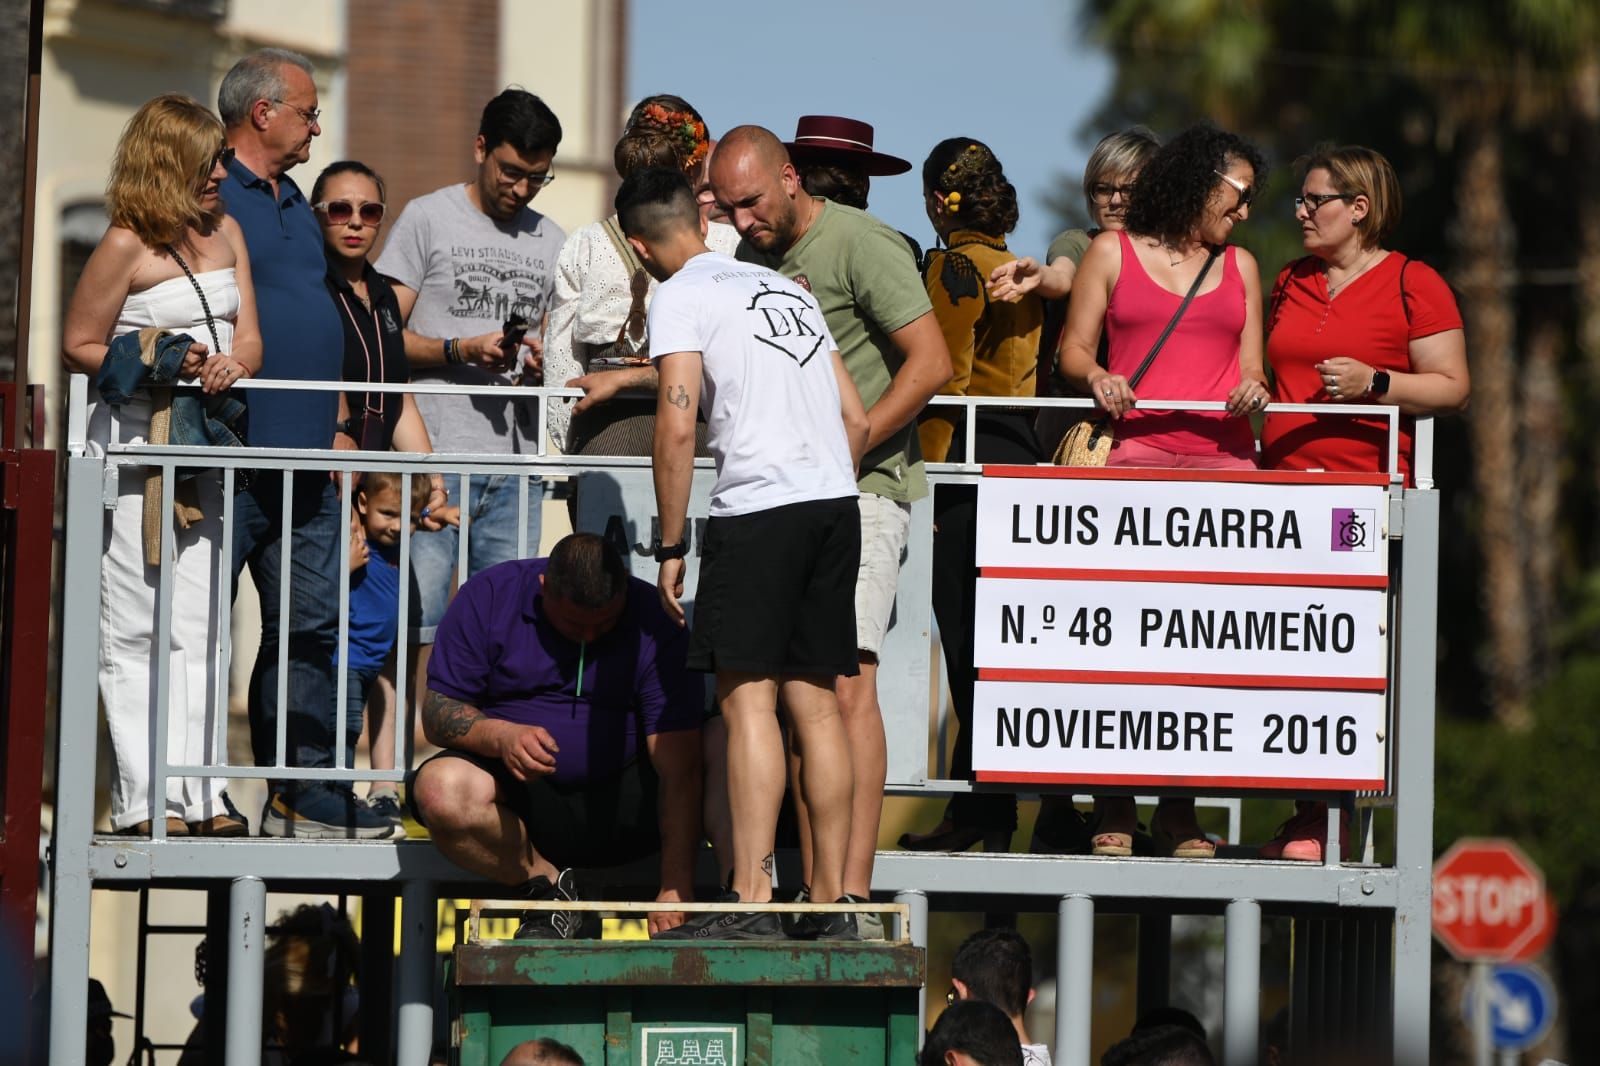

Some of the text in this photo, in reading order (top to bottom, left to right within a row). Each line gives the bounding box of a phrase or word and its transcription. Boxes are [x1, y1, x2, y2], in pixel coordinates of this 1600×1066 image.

[451, 246, 475, 258] LEVI
[478, 247, 523, 264] STRAUSS
[468, 275, 491, 283] QUALITY
[760, 307, 817, 338] DK
[1012, 504, 1302, 550] LUIS ALGARRA
[1068, 606, 1112, 647] 48
[1140, 603, 1355, 654] PANAMEÑO
[996, 707, 1357, 756] NOVIEMBRE 2016
[1432, 874, 1533, 927] STOP
